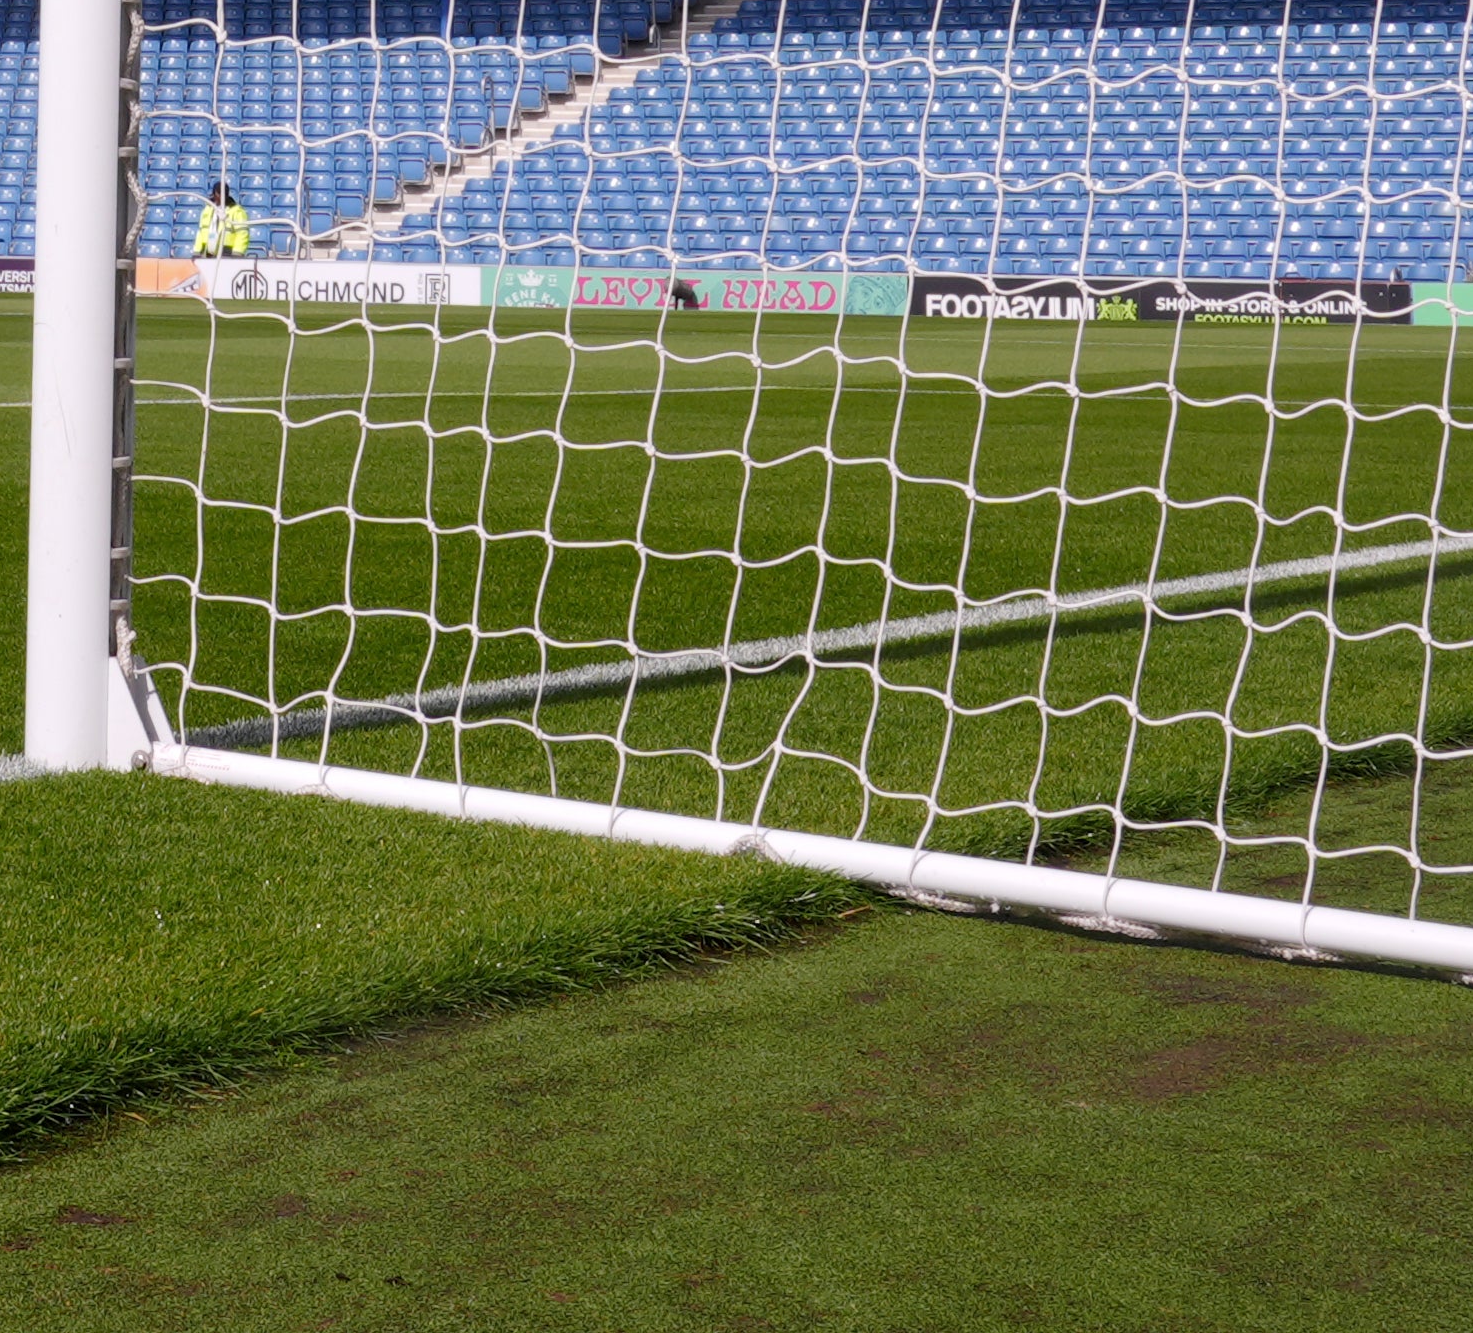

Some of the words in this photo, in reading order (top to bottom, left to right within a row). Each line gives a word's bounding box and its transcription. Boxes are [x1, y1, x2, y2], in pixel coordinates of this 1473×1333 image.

[276, 280, 405, 303] RCHMOND
[722, 278, 838, 311] HEAD
[925, 294, 1095, 320] FOOTASYLUM
[1155, 297, 1201, 311] SHOP
